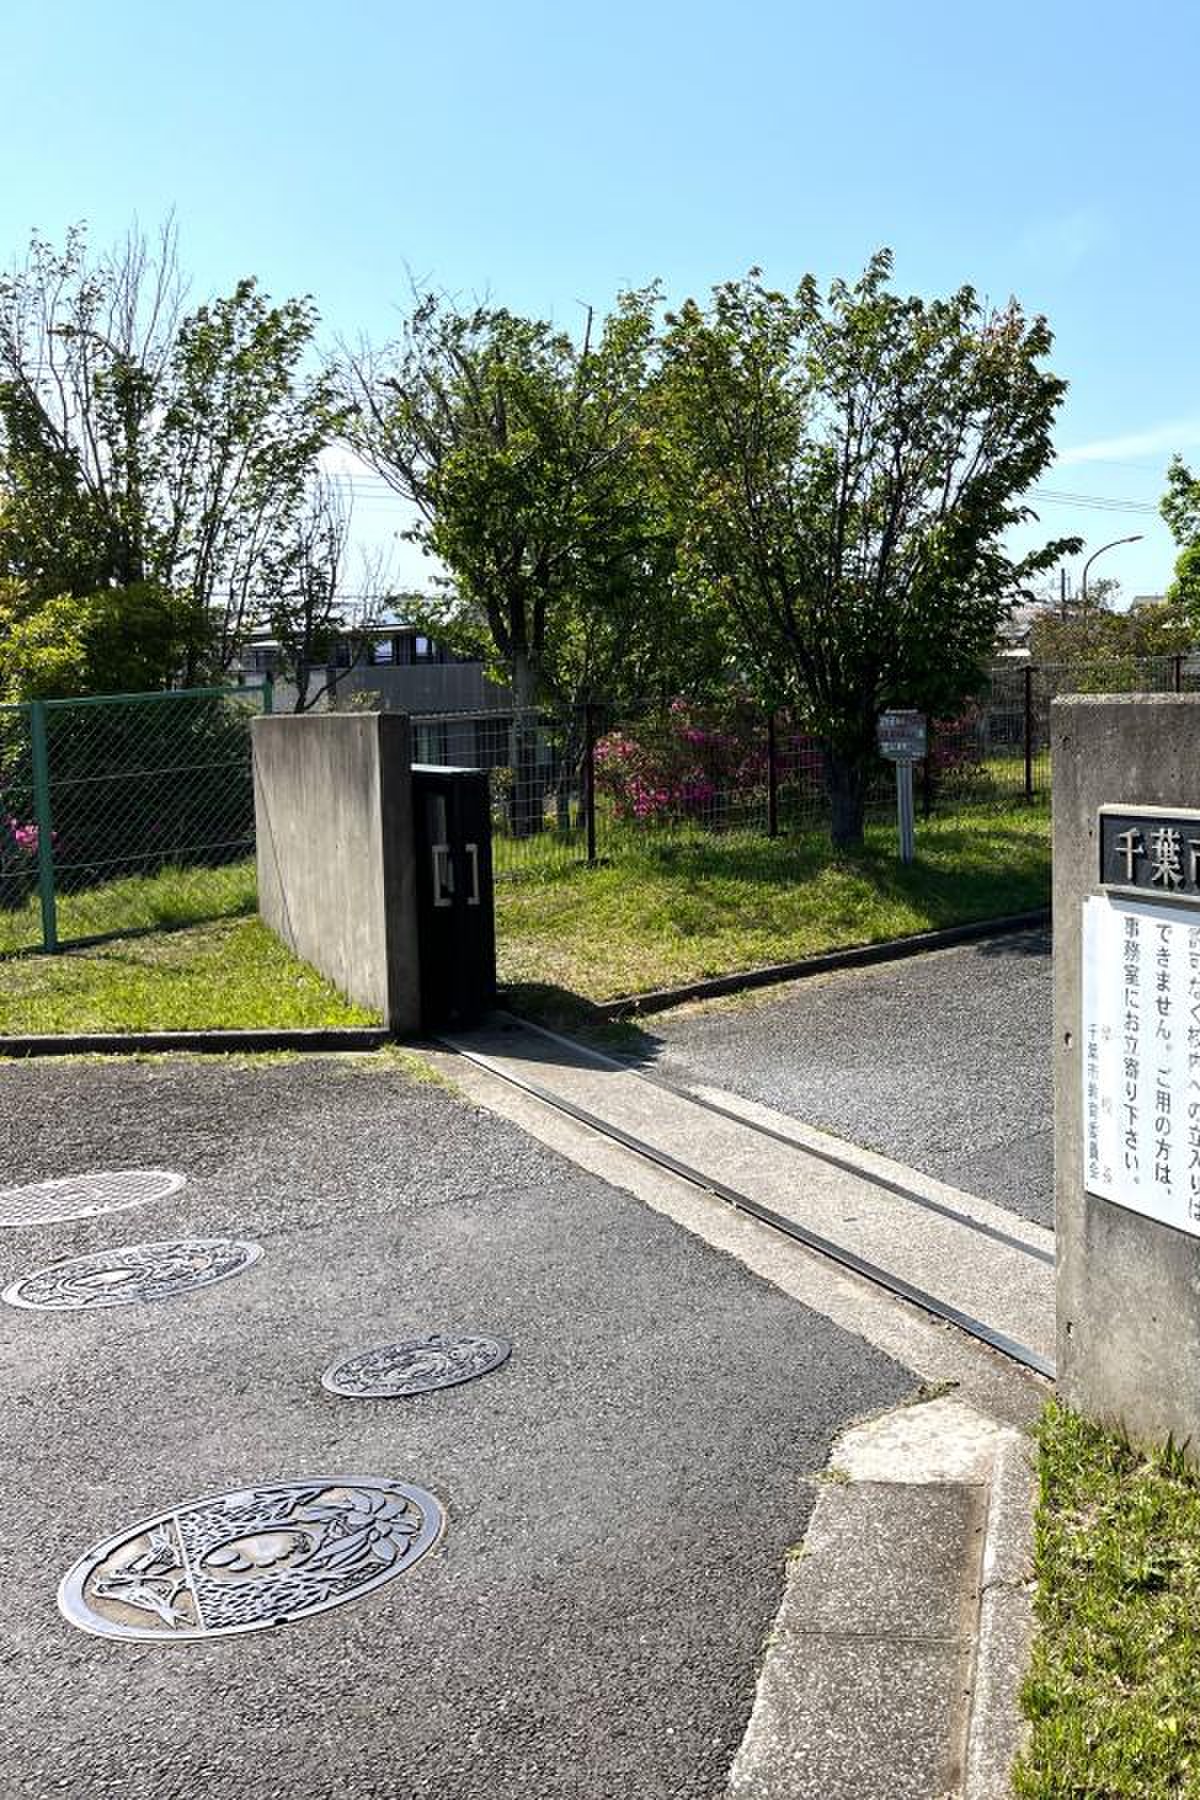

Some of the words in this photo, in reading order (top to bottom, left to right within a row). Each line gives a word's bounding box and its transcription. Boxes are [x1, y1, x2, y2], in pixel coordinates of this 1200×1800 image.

[1124, 917, 1140, 1184] 事務室にお立寄り下さい。
